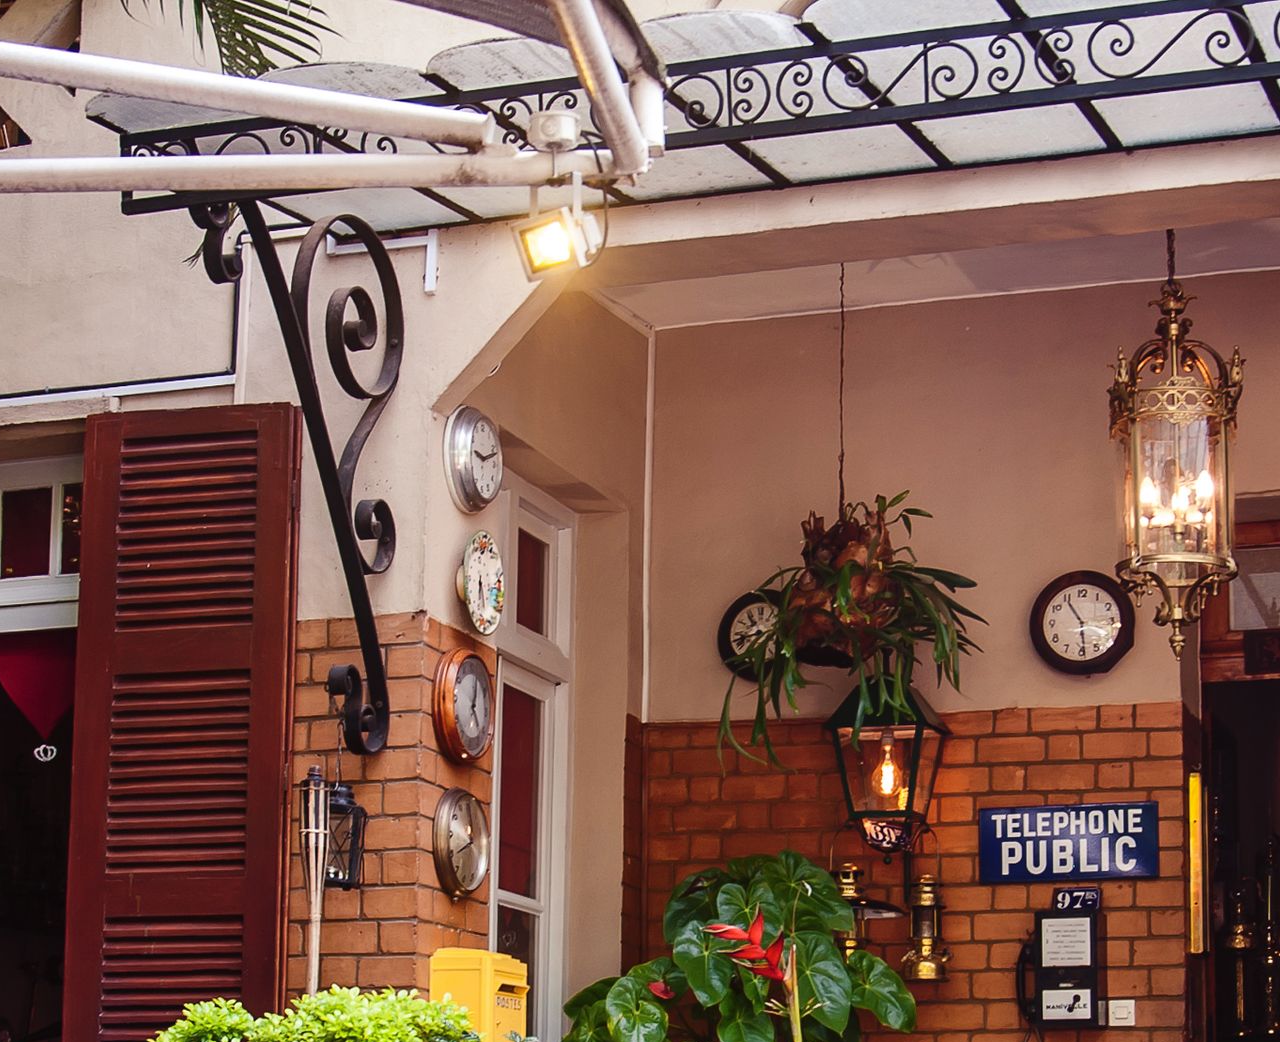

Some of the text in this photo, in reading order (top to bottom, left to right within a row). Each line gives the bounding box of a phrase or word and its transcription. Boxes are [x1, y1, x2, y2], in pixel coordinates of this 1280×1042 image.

[1063, 594, 1071, 602] 11
[1077, 589, 1088, 598] 12
[1095, 593, 1100, 601] 1
[1051, 604, 1062, 613] 10
[1104, 602, 1112, 611] 2
[1048, 619, 1055, 628] 9
[1052, 633, 1059, 643] 8
[1063, 644, 1070, 653] 7
[1093, 643, 1100, 652] 5
[991, 808, 1143, 839] TELEPHONE
[1001, 835, 1137, 876] PUBLIC
